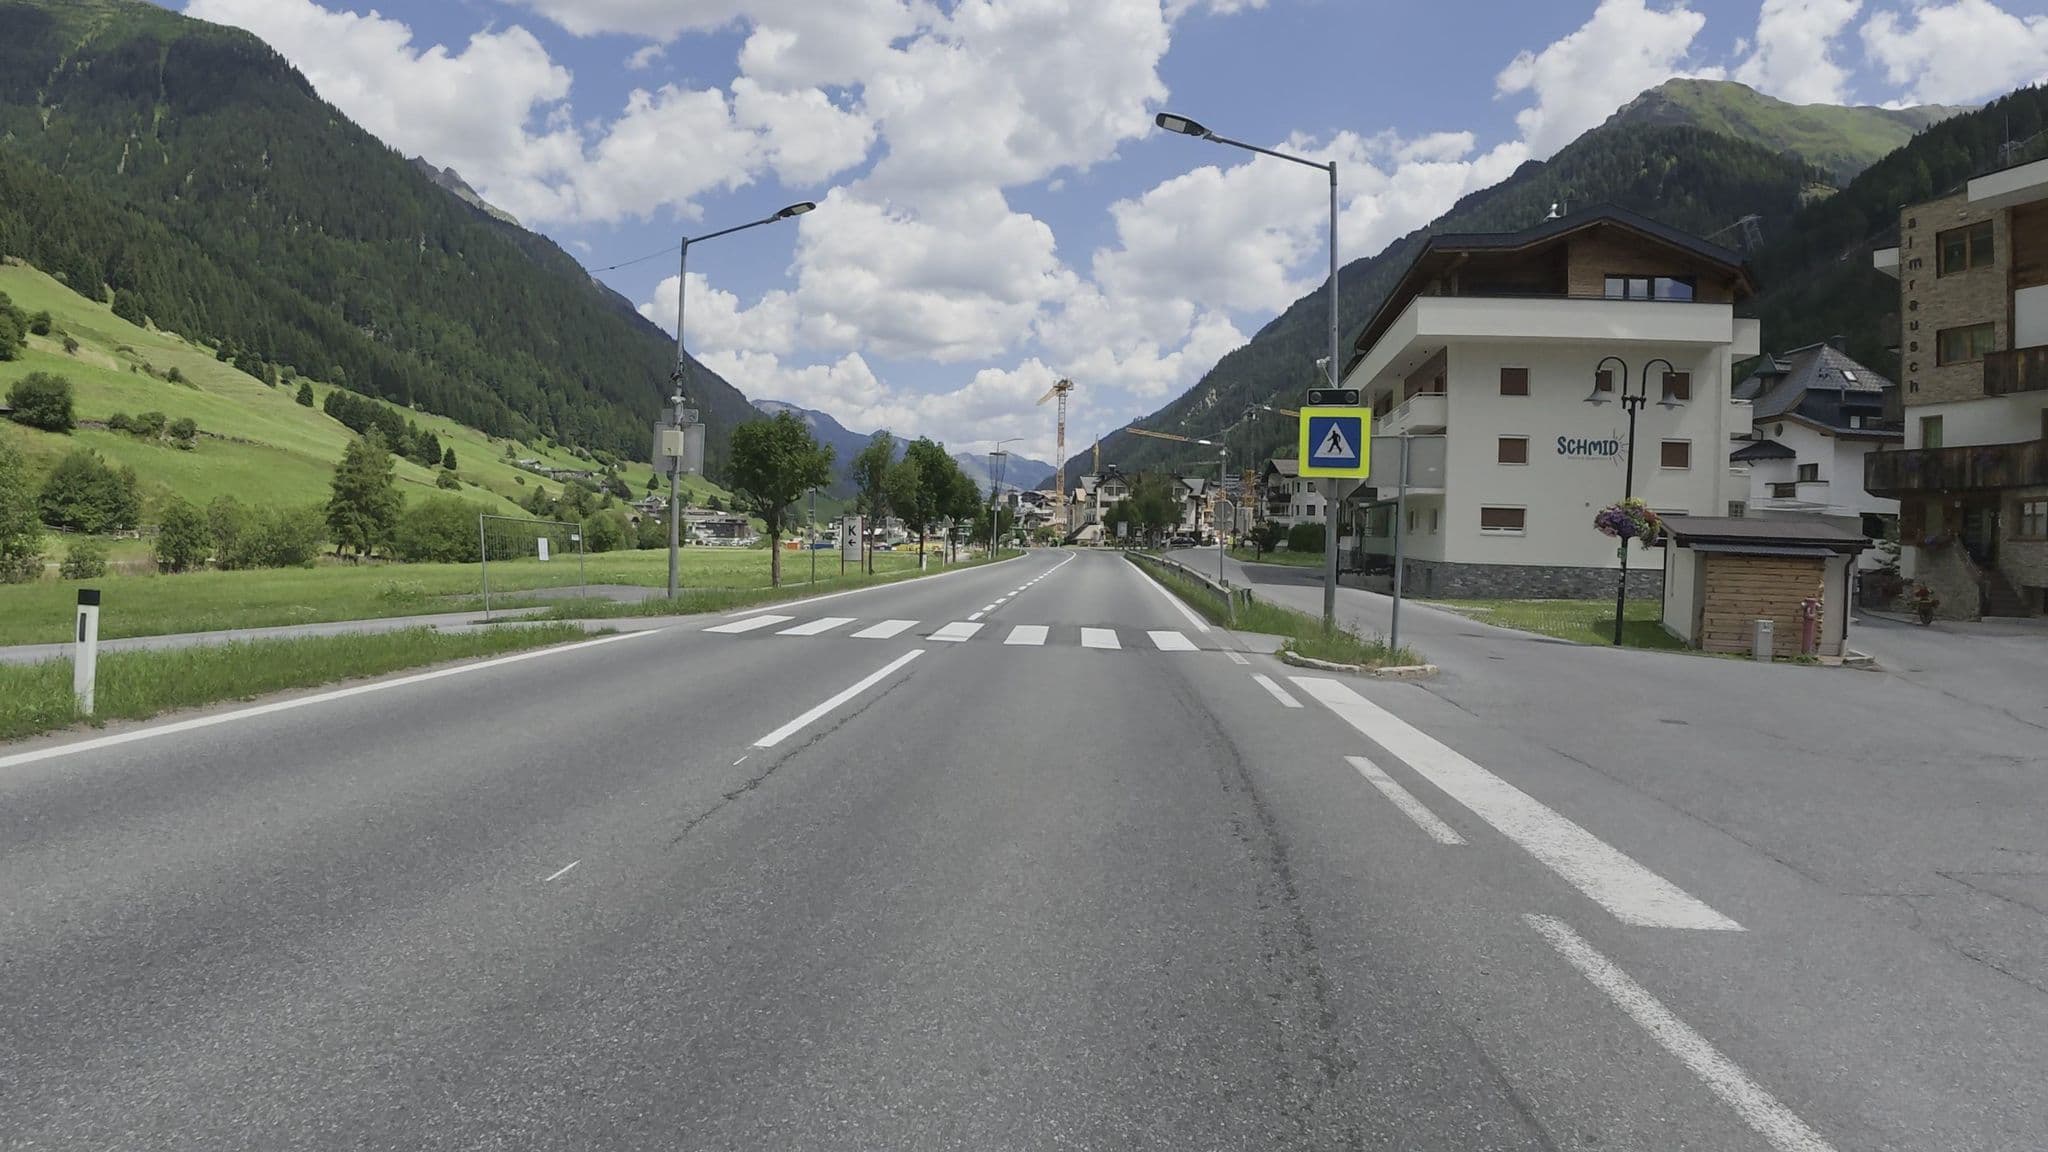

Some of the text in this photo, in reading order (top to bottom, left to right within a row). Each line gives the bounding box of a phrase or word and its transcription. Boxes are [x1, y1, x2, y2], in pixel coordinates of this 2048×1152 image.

[1908, 217, 1922, 393] almrausch
[1557, 436, 1619, 456] SCHMID
[848, 524, 857, 536] K
